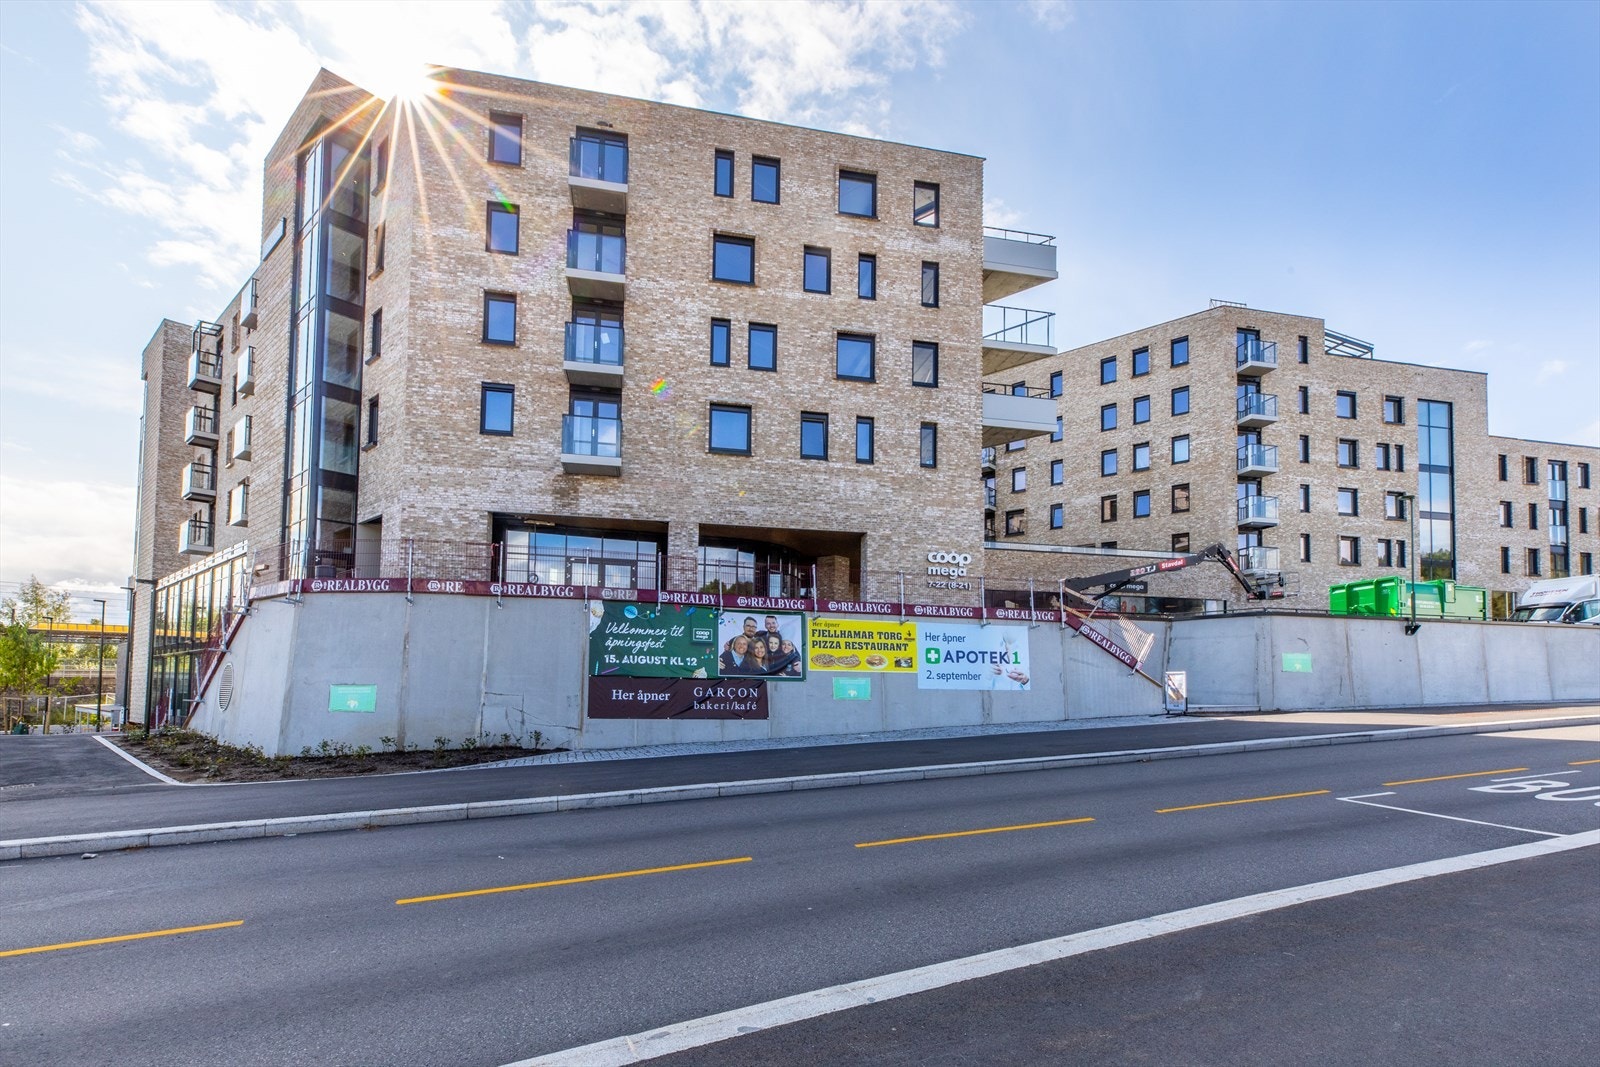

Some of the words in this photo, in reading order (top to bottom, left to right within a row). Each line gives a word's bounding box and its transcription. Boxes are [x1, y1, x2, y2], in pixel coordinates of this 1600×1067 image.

[927, 551, 972, 567] coop
[1161, 559, 1184, 569] Stavdal
[927, 566, 967, 580] mega
[327, 579, 390, 591] REALBYGG
[445, 581, 465, 593] RE
[507, 584, 574, 597] REALBYGG
[927, 580, 946, 588] 7-22
[947, 581, 972, 591] (8-21)
[1126, 583, 1145, 591] mega
[673, 592, 718, 605] REALBY
[751, 597, 805, 610] REALBYGG
[841, 601, 891, 614] REALBYGG
[926, 605, 973, 617] REALBYGG
[605, 621, 668, 636] Velkommen
[670, 624, 685, 637] til
[811, 628, 874, 640] FJELLHAMAR
[876, 631, 903, 641] TORG
[924, 631, 941, 642] Her
[942, 632, 967, 645] åpner
[604, 636, 667, 654] åpningsfest
[811, 640, 842, 650] PIZZA
[844, 640, 909, 652] RESTAURANT
[1090, 631, 1132, 664] REALBYGG
[604, 654, 619, 664] 15.
[621, 655, 668, 665] AUGUST
[670, 656, 685, 666] KL
[686, 657, 698, 666] 12
[943, 649, 1011, 665] APOTEK
[1011, 651, 1021, 665] 1
[926, 669, 935, 680] 2.
[936, 671, 982, 683] september
[611, 689, 635, 701] Her
[637, 689, 671, 704] åpner
[693, 686, 759, 700] GARÇON
[693, 700, 758, 711] bakeri/kafé
[1467, 780, 1600, 807] BU
